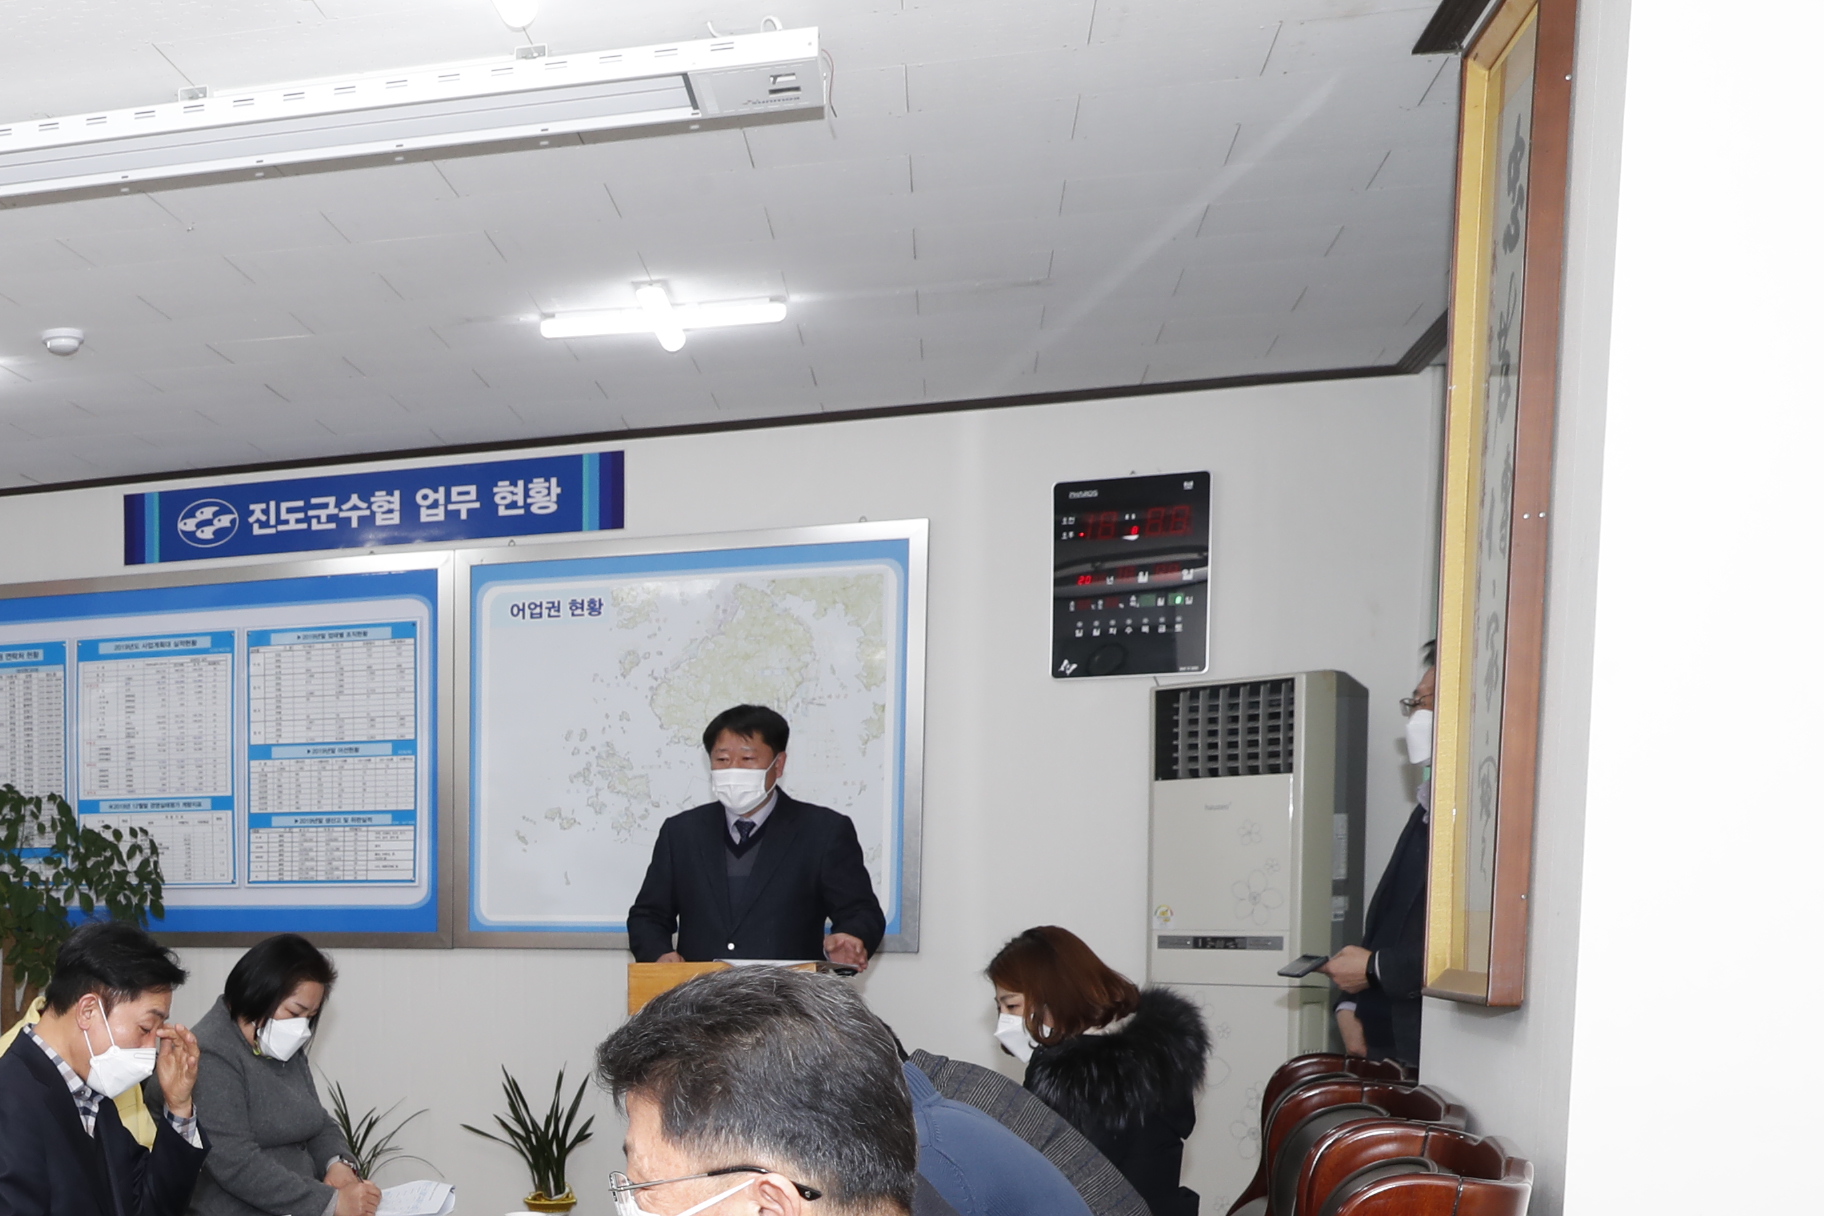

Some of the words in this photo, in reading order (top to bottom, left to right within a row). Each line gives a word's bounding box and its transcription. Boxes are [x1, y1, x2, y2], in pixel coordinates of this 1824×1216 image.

[246, 489, 401, 536] 진도군수협
[415, 485, 480, 522] 업무
[492, 477, 562, 516] 현황
[510, 600, 561, 620] 어업권
[568, 597, 604, 617] 현황
